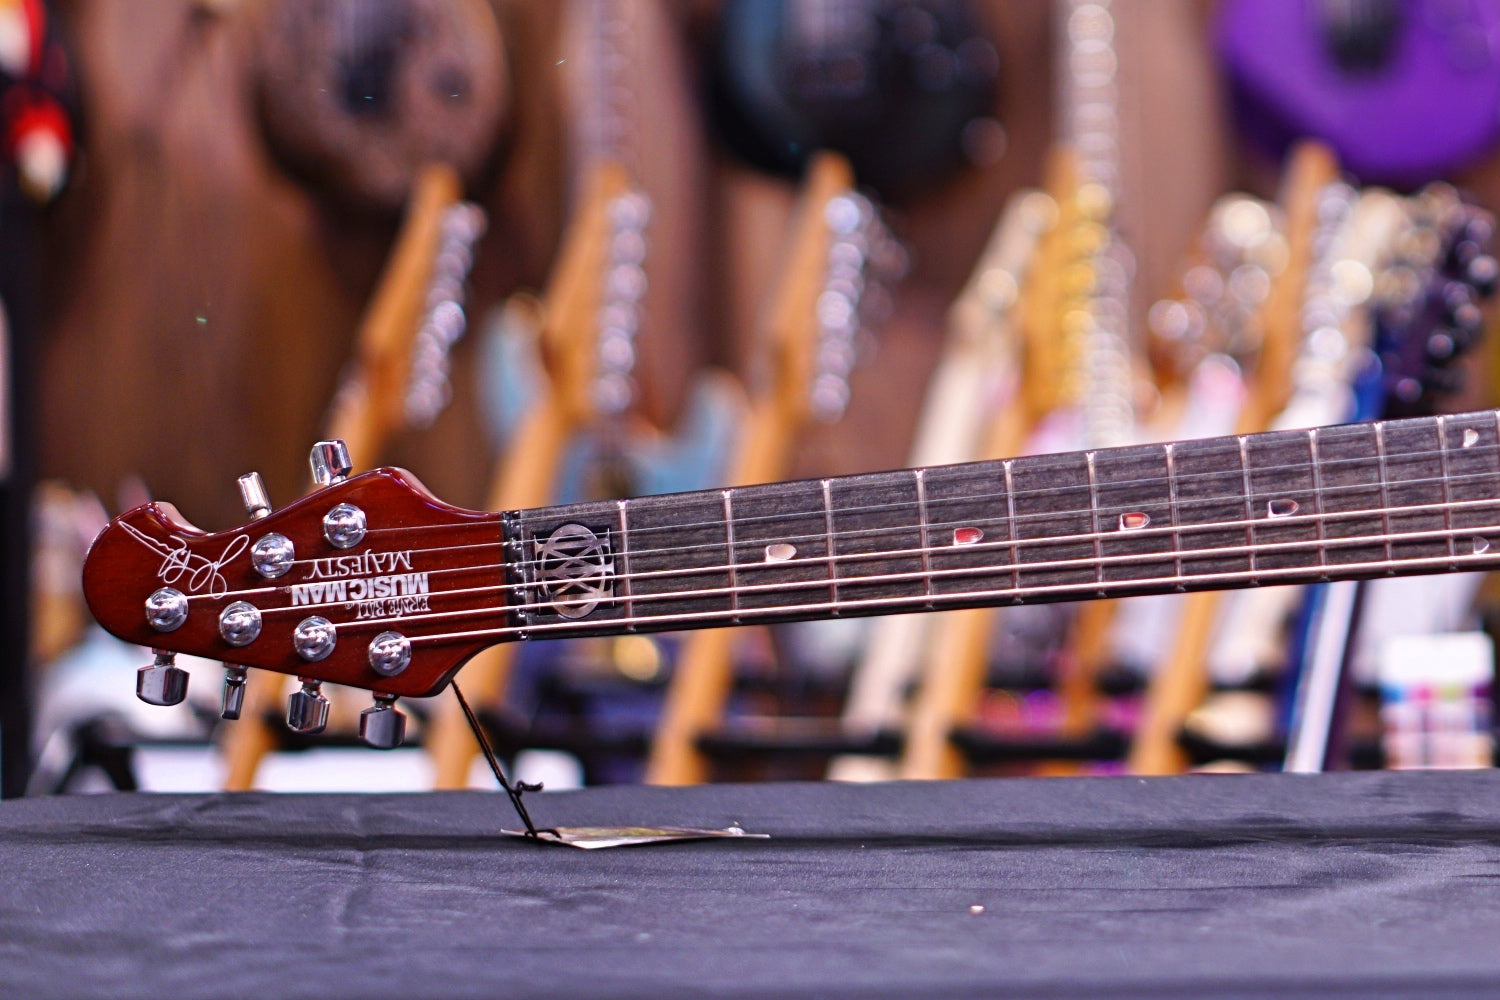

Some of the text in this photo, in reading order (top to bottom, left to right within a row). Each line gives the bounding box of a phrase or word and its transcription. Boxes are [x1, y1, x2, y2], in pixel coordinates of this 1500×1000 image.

[308, 549, 414, 580] MAJESTY
[291, 572, 430, 606] MUSIC MAN
[355, 595, 432, 620] ERNIE BALL
